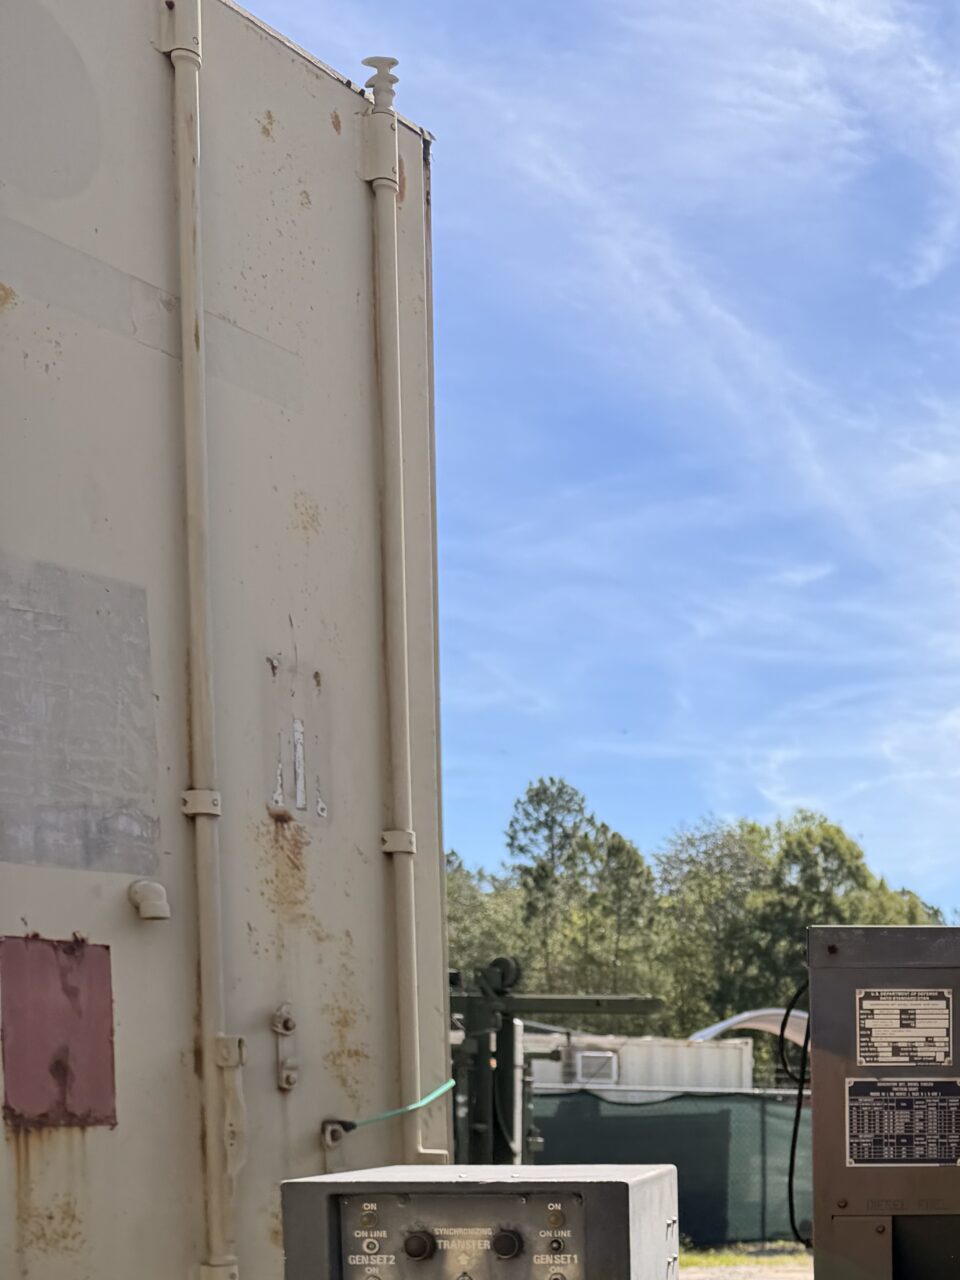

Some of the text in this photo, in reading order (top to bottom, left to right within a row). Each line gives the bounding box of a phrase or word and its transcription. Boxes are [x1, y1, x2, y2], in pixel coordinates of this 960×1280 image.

[363, 1203, 377, 1211] ON
[547, 1203, 562, 1211] ON
[354, 1230, 387, 1238] ON LINE
[539, 1230, 572, 1238] ON LINE
[436, 1239, 491, 1250] TRANSFER
[348, 1255, 396, 1265] GEN SET 2
[533, 1254, 578, 1265] GEN SET 1
[365, 1267, 379, 1275] ON
